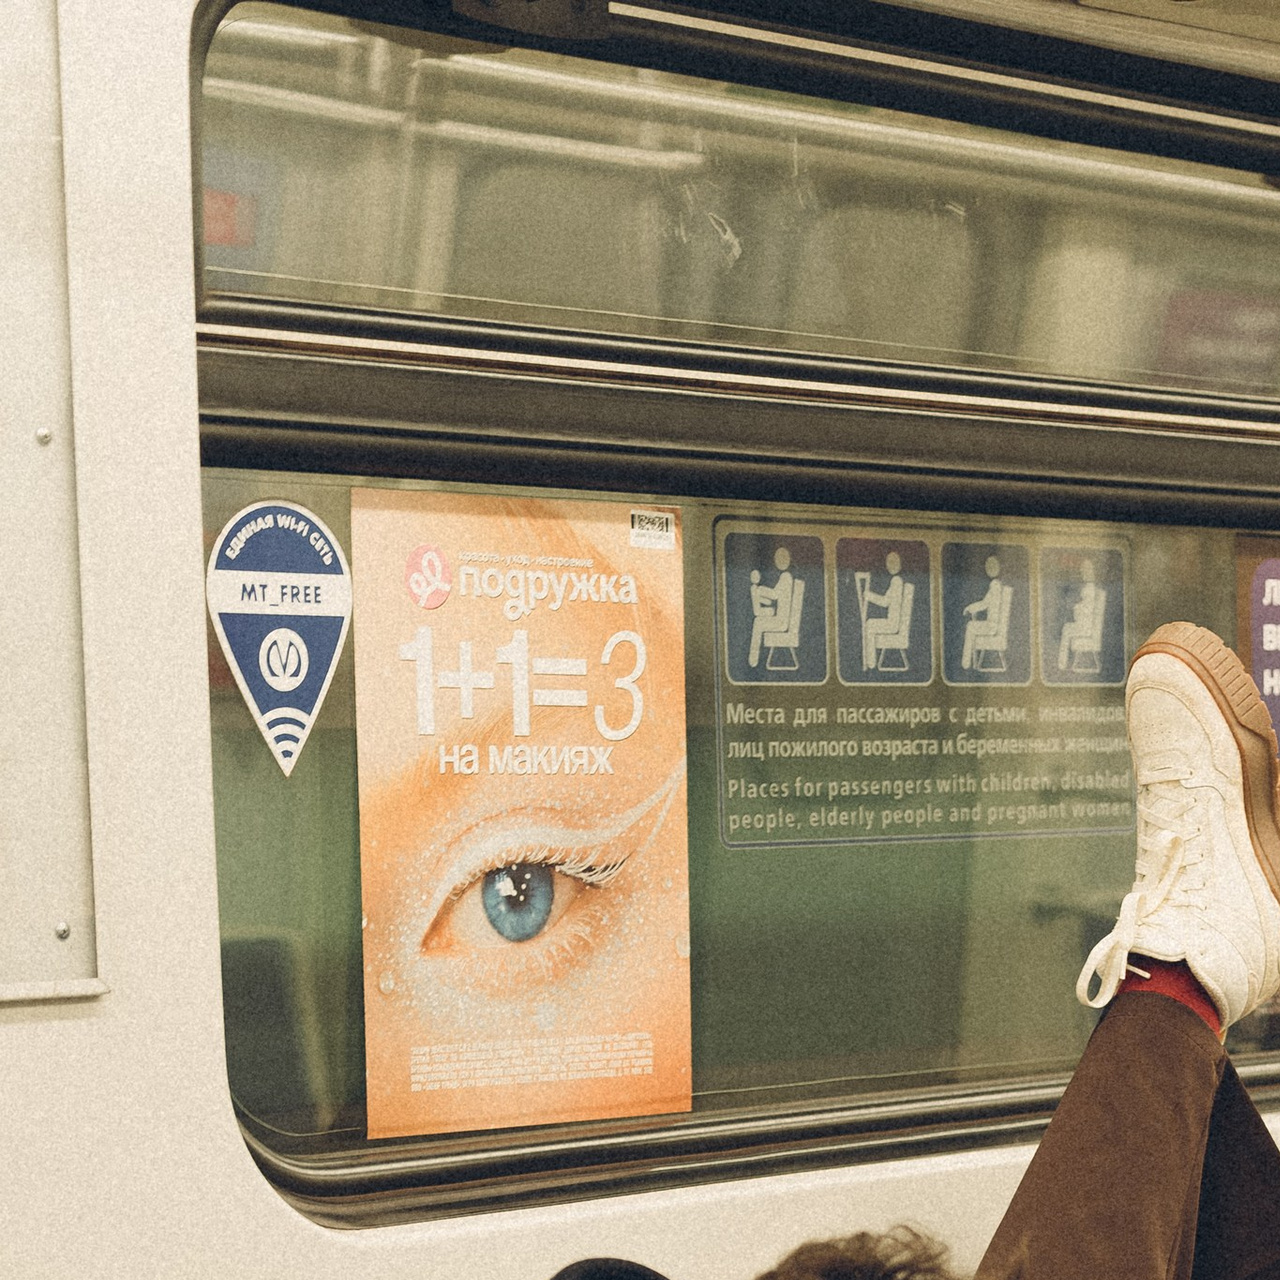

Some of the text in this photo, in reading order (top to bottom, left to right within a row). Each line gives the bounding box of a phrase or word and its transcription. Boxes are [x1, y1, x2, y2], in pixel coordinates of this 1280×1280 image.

[225, 514, 275, 561] ЕДИНАЯ
[309, 532, 333, 566] СЕТЬ
[241, 583, 322, 607] MT_FREE
[458, 565, 638, 621] подружка
[400, 626, 647, 741] 1+1=3
[726, 703, 786, 725] Места
[793, 707, 828, 728] для
[836, 707, 941, 729] пассажиров
[949, 707, 958, 723] с
[439, 743, 615, 776] на макияж
[727, 741, 765, 762] лиц
[768, 740, 859, 758] пожилого
[862, 739, 938, 761] возраста
[942, 739, 954, 754] и
[956, 732, 1060, 760] беременных
[728, 769, 1130, 801] Places for passengers with children, disabled
[729, 801, 1131, 834] people, elderly people and pregnant women
